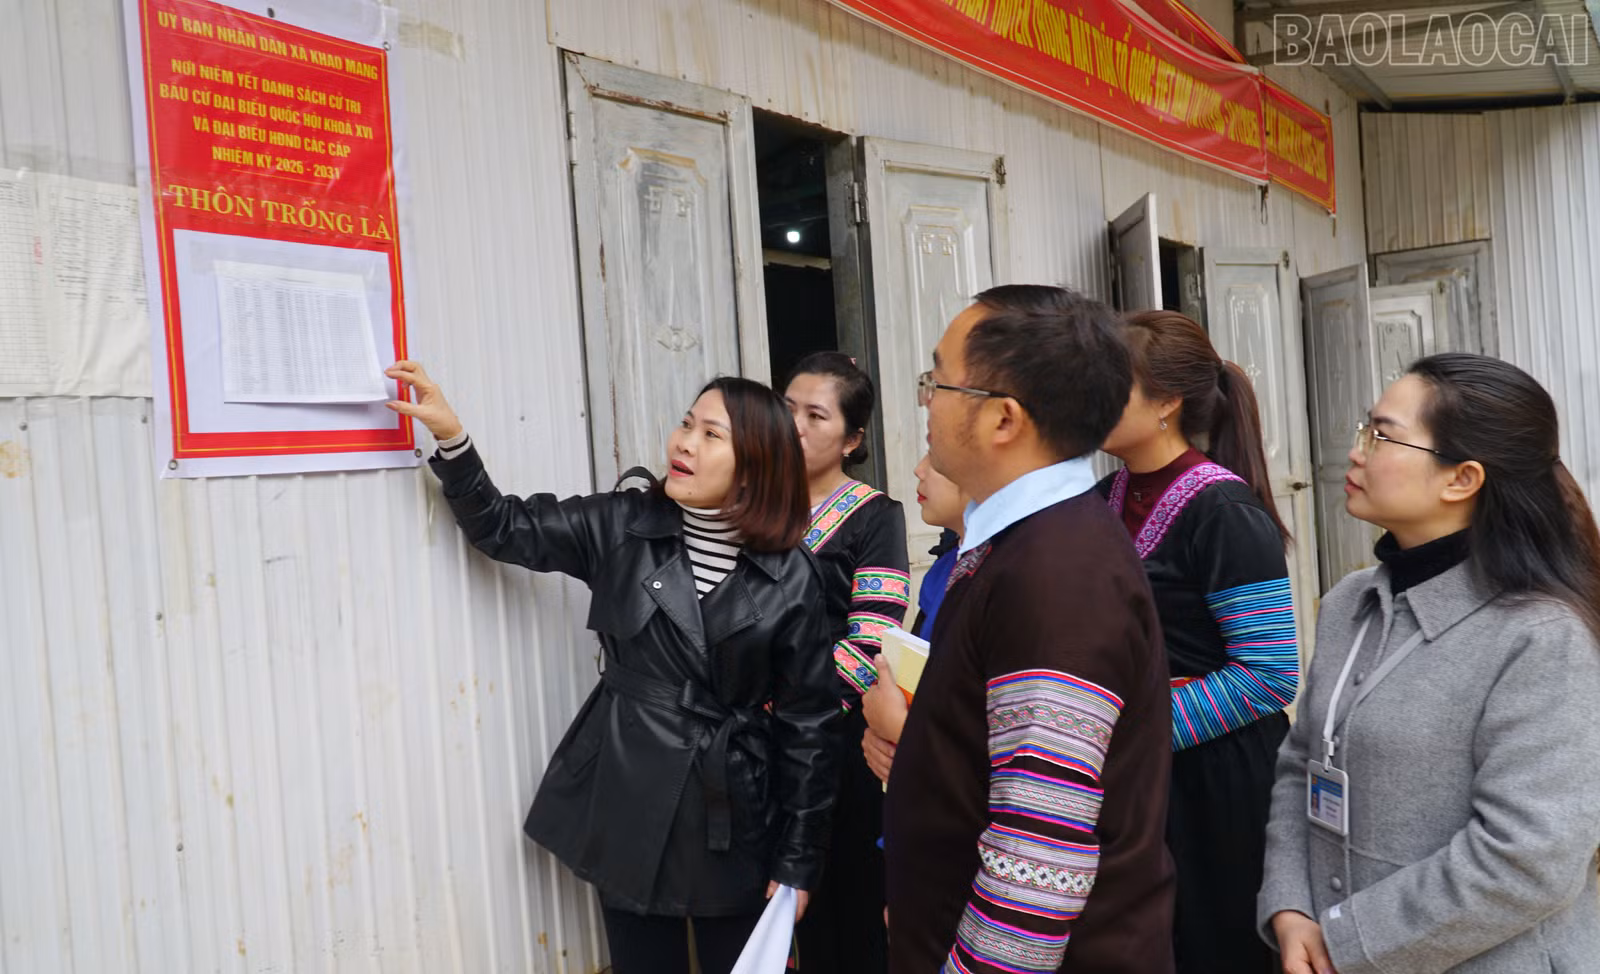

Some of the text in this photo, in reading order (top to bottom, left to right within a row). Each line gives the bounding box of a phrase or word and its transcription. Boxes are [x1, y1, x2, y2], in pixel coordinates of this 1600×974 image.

[181, 16, 213, 38] BAN
[216, 25, 257, 49] NHÂN
[259, 34, 288, 56] DÂN
[289, 43, 308, 62] XÃ
[310, 49, 343, 70] KHAO
[345, 58, 379, 80] MANG
[159, 81, 189, 102] BẦU
[213, 93, 236, 115] ĐẠI
[238, 96, 267, 118] BIỂU
[269, 104, 301, 125] QUỐC
[303, 112, 322, 132] HỘI
[355, 124, 374, 140] XVI
[171, 58, 196, 77] NƠI
[199, 64, 235, 85] NIÊM
[236, 70, 259, 91] YẾT
[261, 78, 295, 98] DANH
[296, 85, 327, 106] SÁCH
[345, 98, 362, 114] TRI
[192, 114, 352, 158] VÀ ĐẠI BIỂU HĐND CÁC CẤP
[212, 146, 255, 168] NHIỆM
[256, 151, 273, 170] KỲ
[275, 157, 305, 175] 2026
[312, 164, 341, 180] 2031
[168, 184, 392, 241] THÔN TRỐNG LÀ
